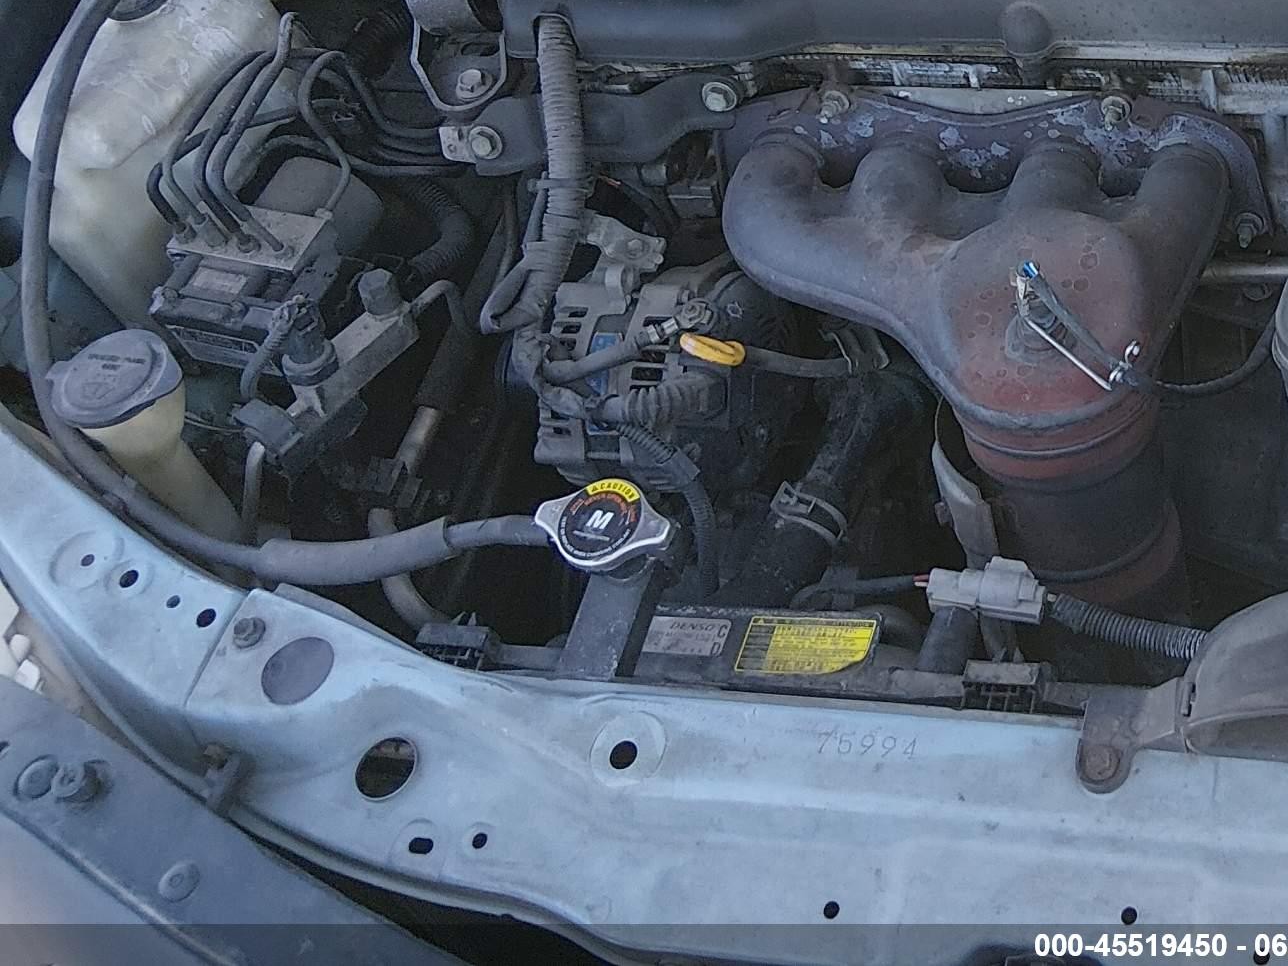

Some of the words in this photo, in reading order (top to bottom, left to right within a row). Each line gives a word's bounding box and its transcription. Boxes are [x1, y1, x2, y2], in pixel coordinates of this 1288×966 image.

[600, 482, 635, 501] CAUTION
[586, 509, 615, 530] M
[670, 621, 716, 632] DENSO
